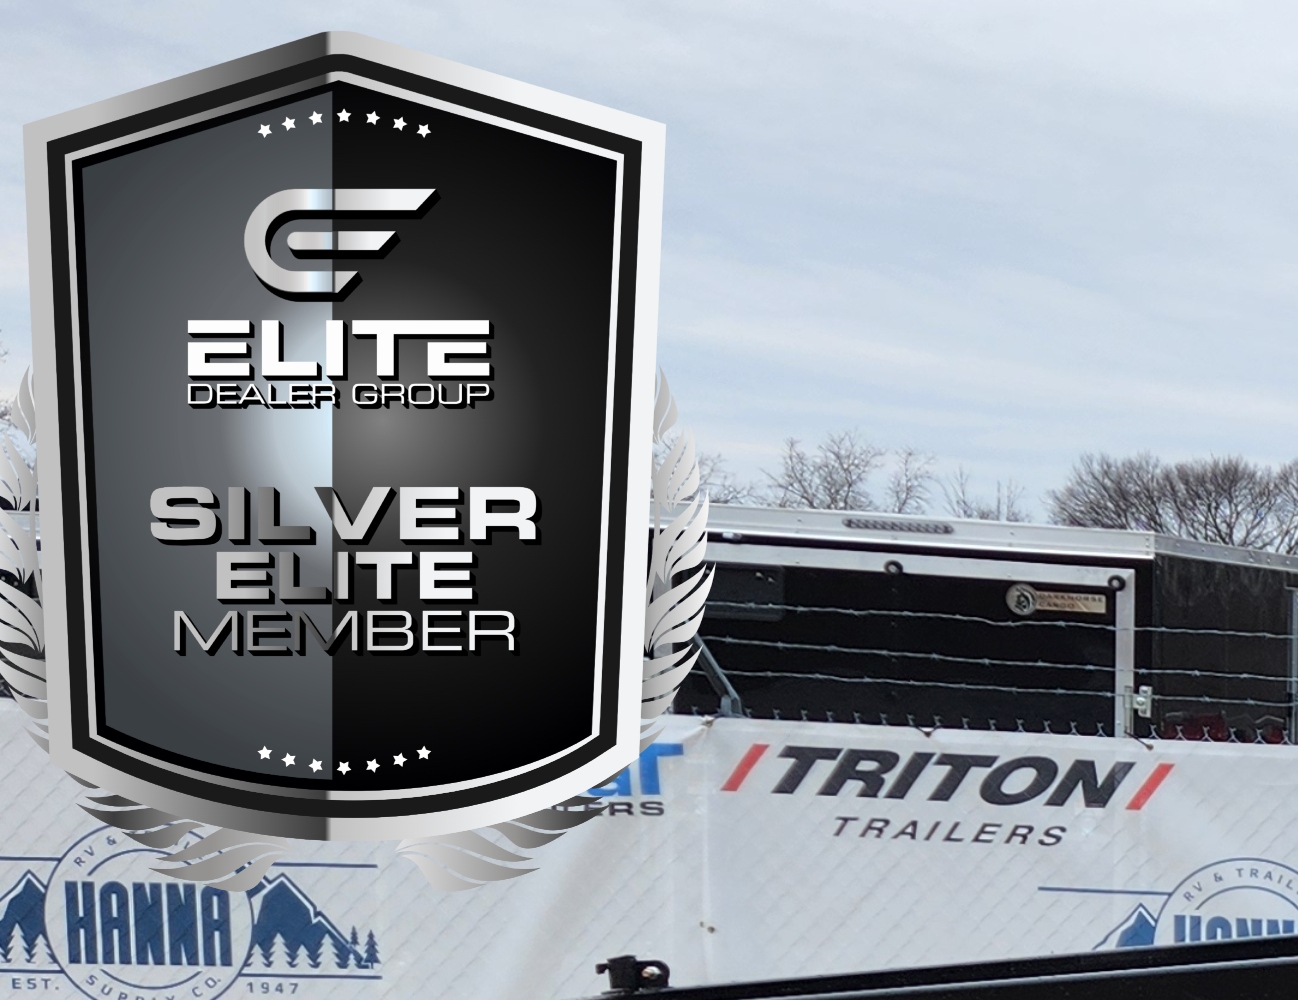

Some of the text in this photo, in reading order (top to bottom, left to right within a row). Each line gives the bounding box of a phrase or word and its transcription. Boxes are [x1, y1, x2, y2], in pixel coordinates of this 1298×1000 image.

[771, 744, 1137, 809] TRITON
[832, 816, 1068, 847] TRAILERS
[74, 845, 96, 867] RV
[106, 835, 117, 846] &
[1183, 881, 1203, 902] RV
[1213, 872, 1223, 882] &
[65, 880, 233, 967] HANNA
[11, 977, 60, 991] EST.
[192, 977, 222, 998] CO.
[246, 982, 299, 994] 1947
